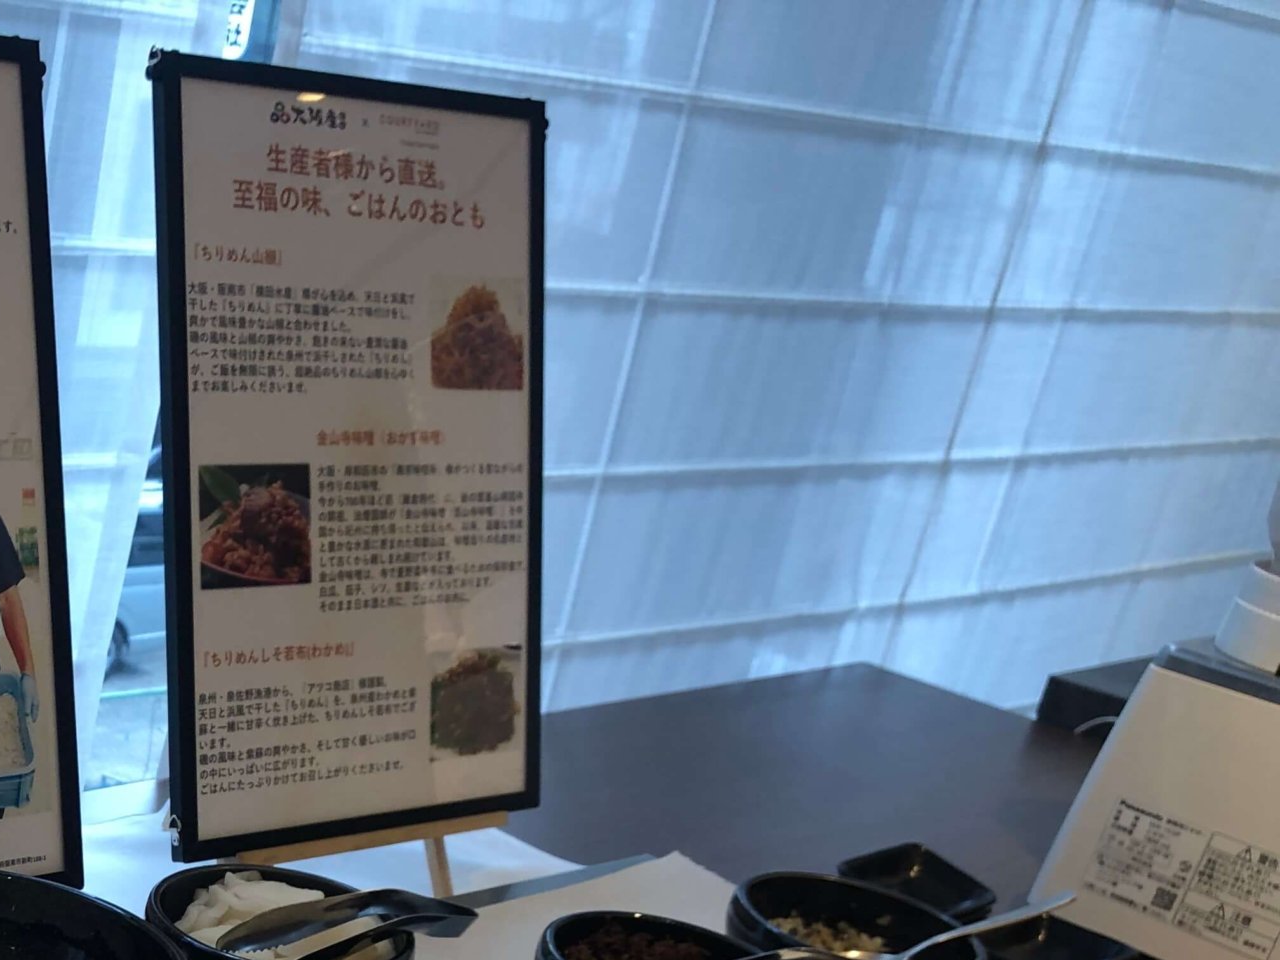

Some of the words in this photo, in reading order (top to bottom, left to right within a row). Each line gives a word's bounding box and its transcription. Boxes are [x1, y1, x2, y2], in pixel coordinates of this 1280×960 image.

[232, 178, 486, 230] 至福の味、ごはんのおとも
